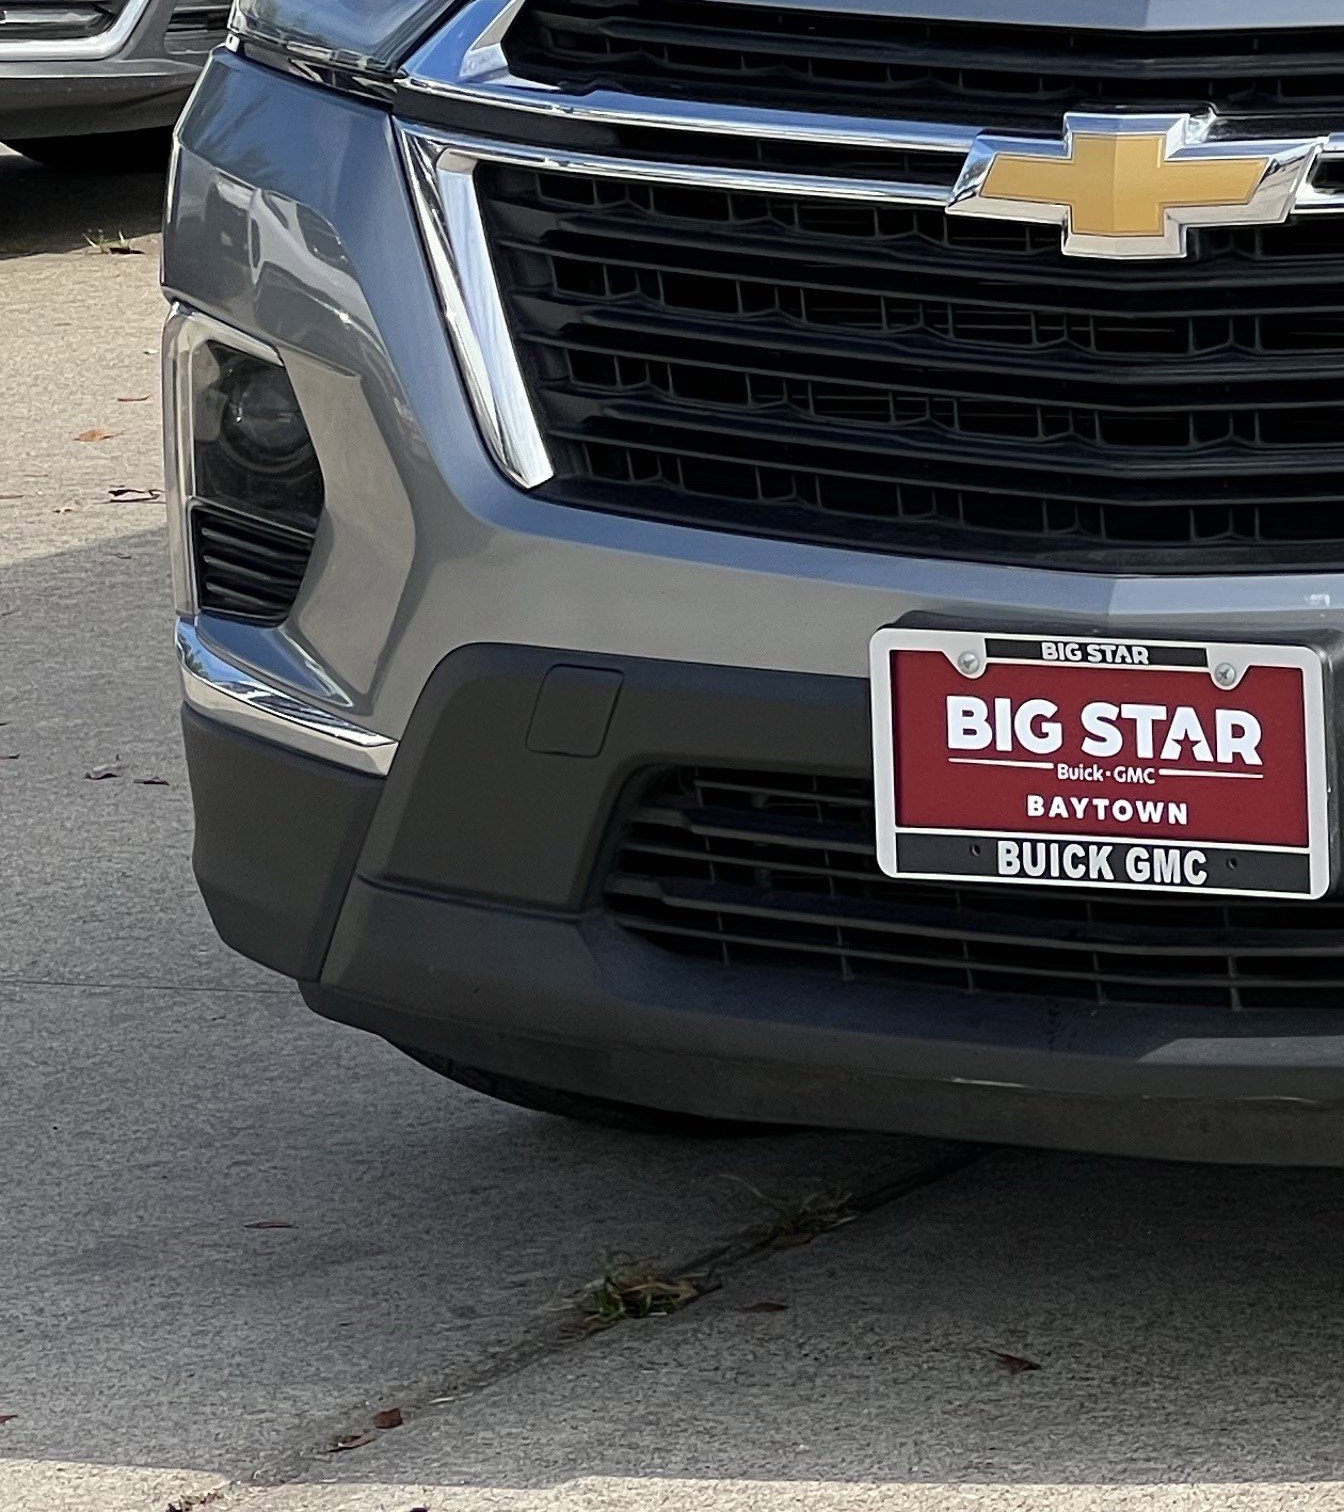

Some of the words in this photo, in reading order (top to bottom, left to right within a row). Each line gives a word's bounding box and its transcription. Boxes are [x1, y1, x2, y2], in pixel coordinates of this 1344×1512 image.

[1041, 641, 1084, 662] BIG
[1086, 643, 1150, 665] STAR
[946, 695, 1063, 755] BIG
[1081, 701, 1264, 766] STAR
[1057, 763, 1104, 782] Buick
[1113, 765, 1156, 785] GMC
[1026, 794, 1188, 826] BAYTOWN
[997, 840, 1115, 880] BUICK
[1125, 846, 1208, 885] GMC
